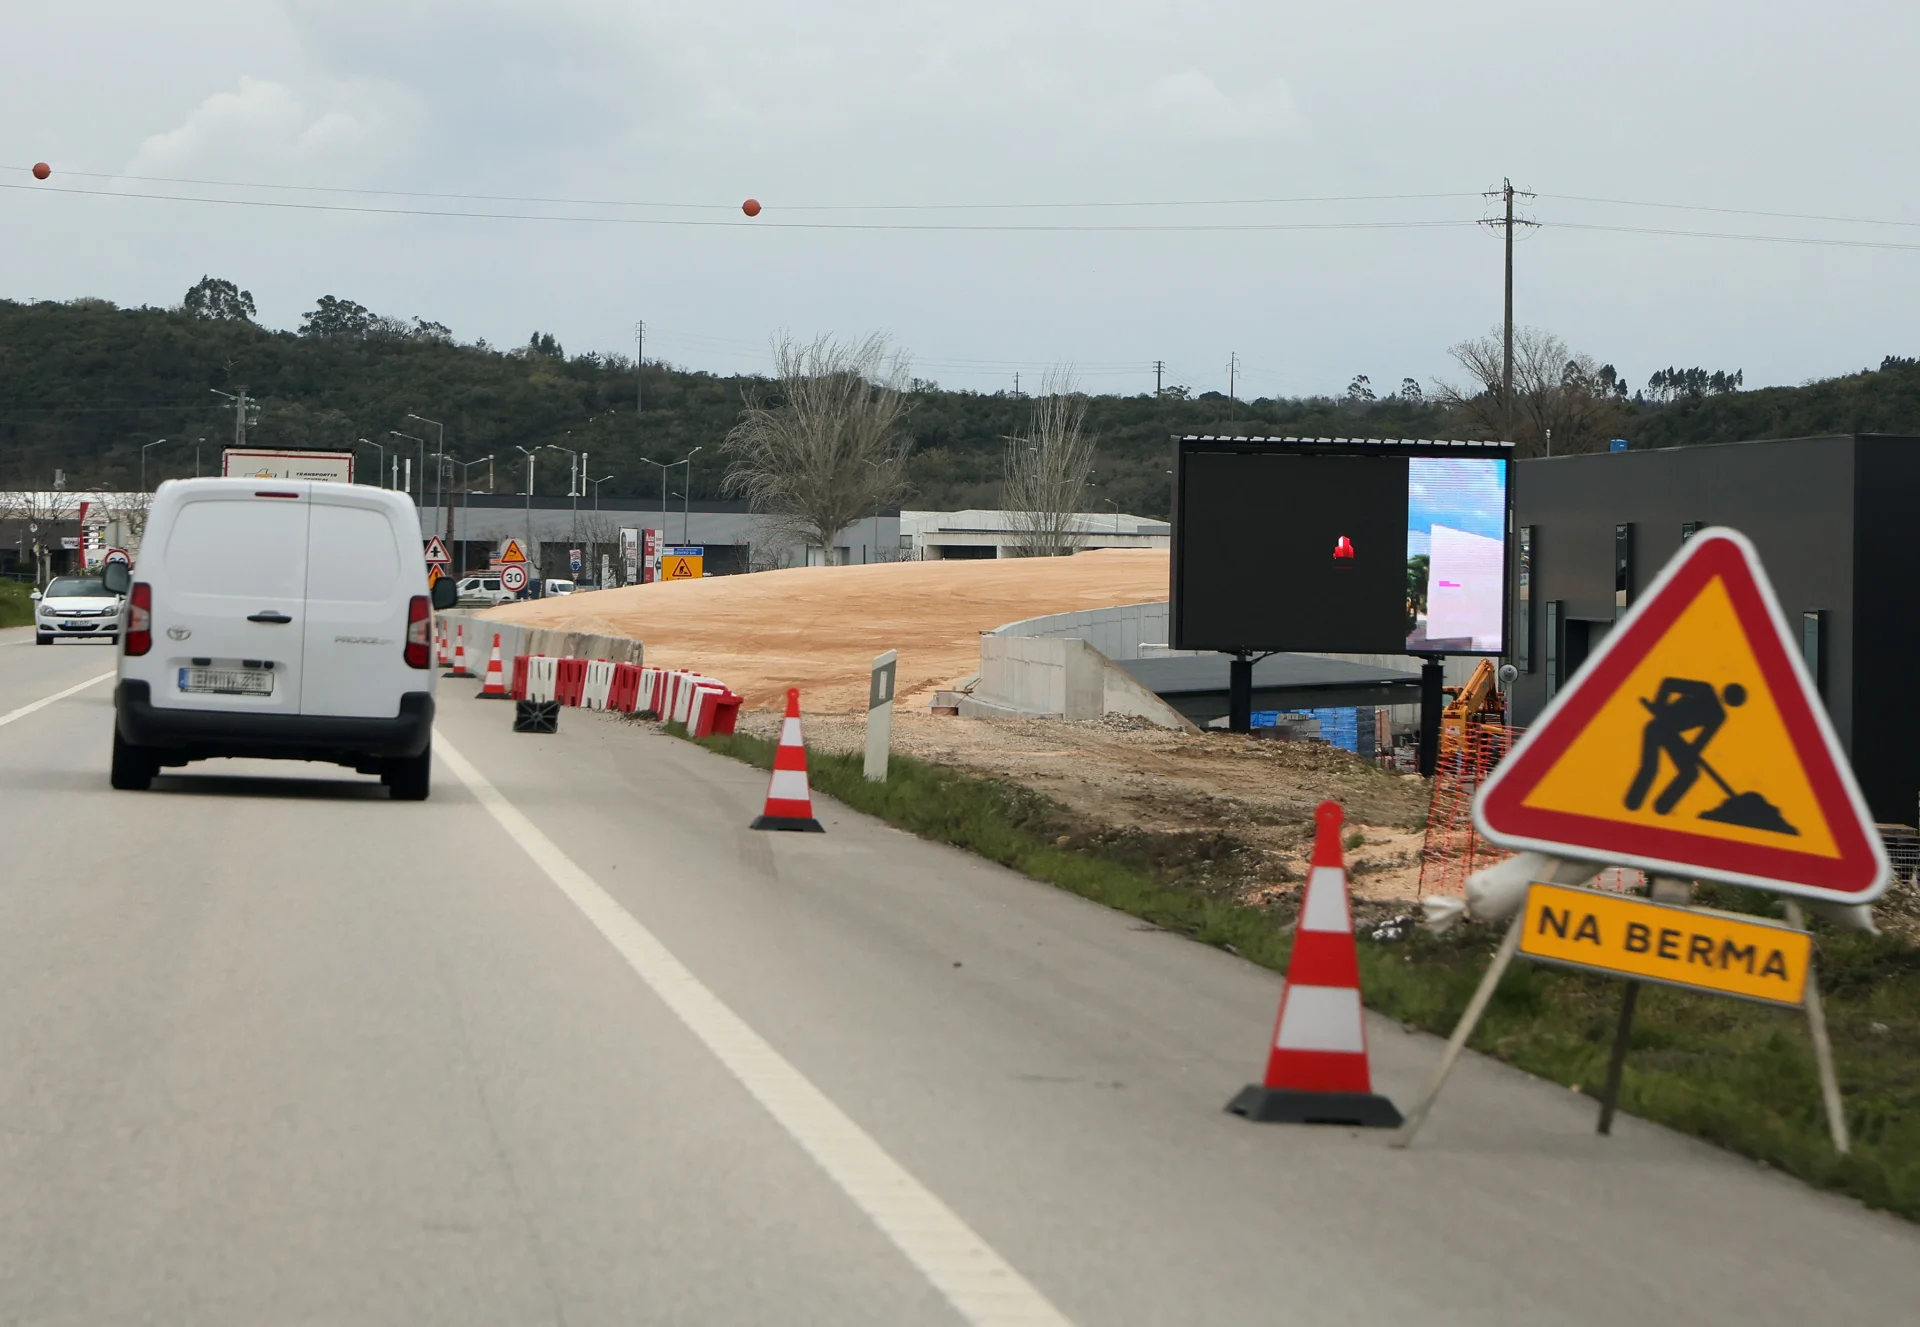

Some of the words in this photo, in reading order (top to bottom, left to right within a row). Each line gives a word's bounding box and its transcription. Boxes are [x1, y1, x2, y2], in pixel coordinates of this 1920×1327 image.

[505, 573, 522, 583] 30
[1537, 904, 1602, 946] NA
[1623, 920, 1789, 982] BERMA
